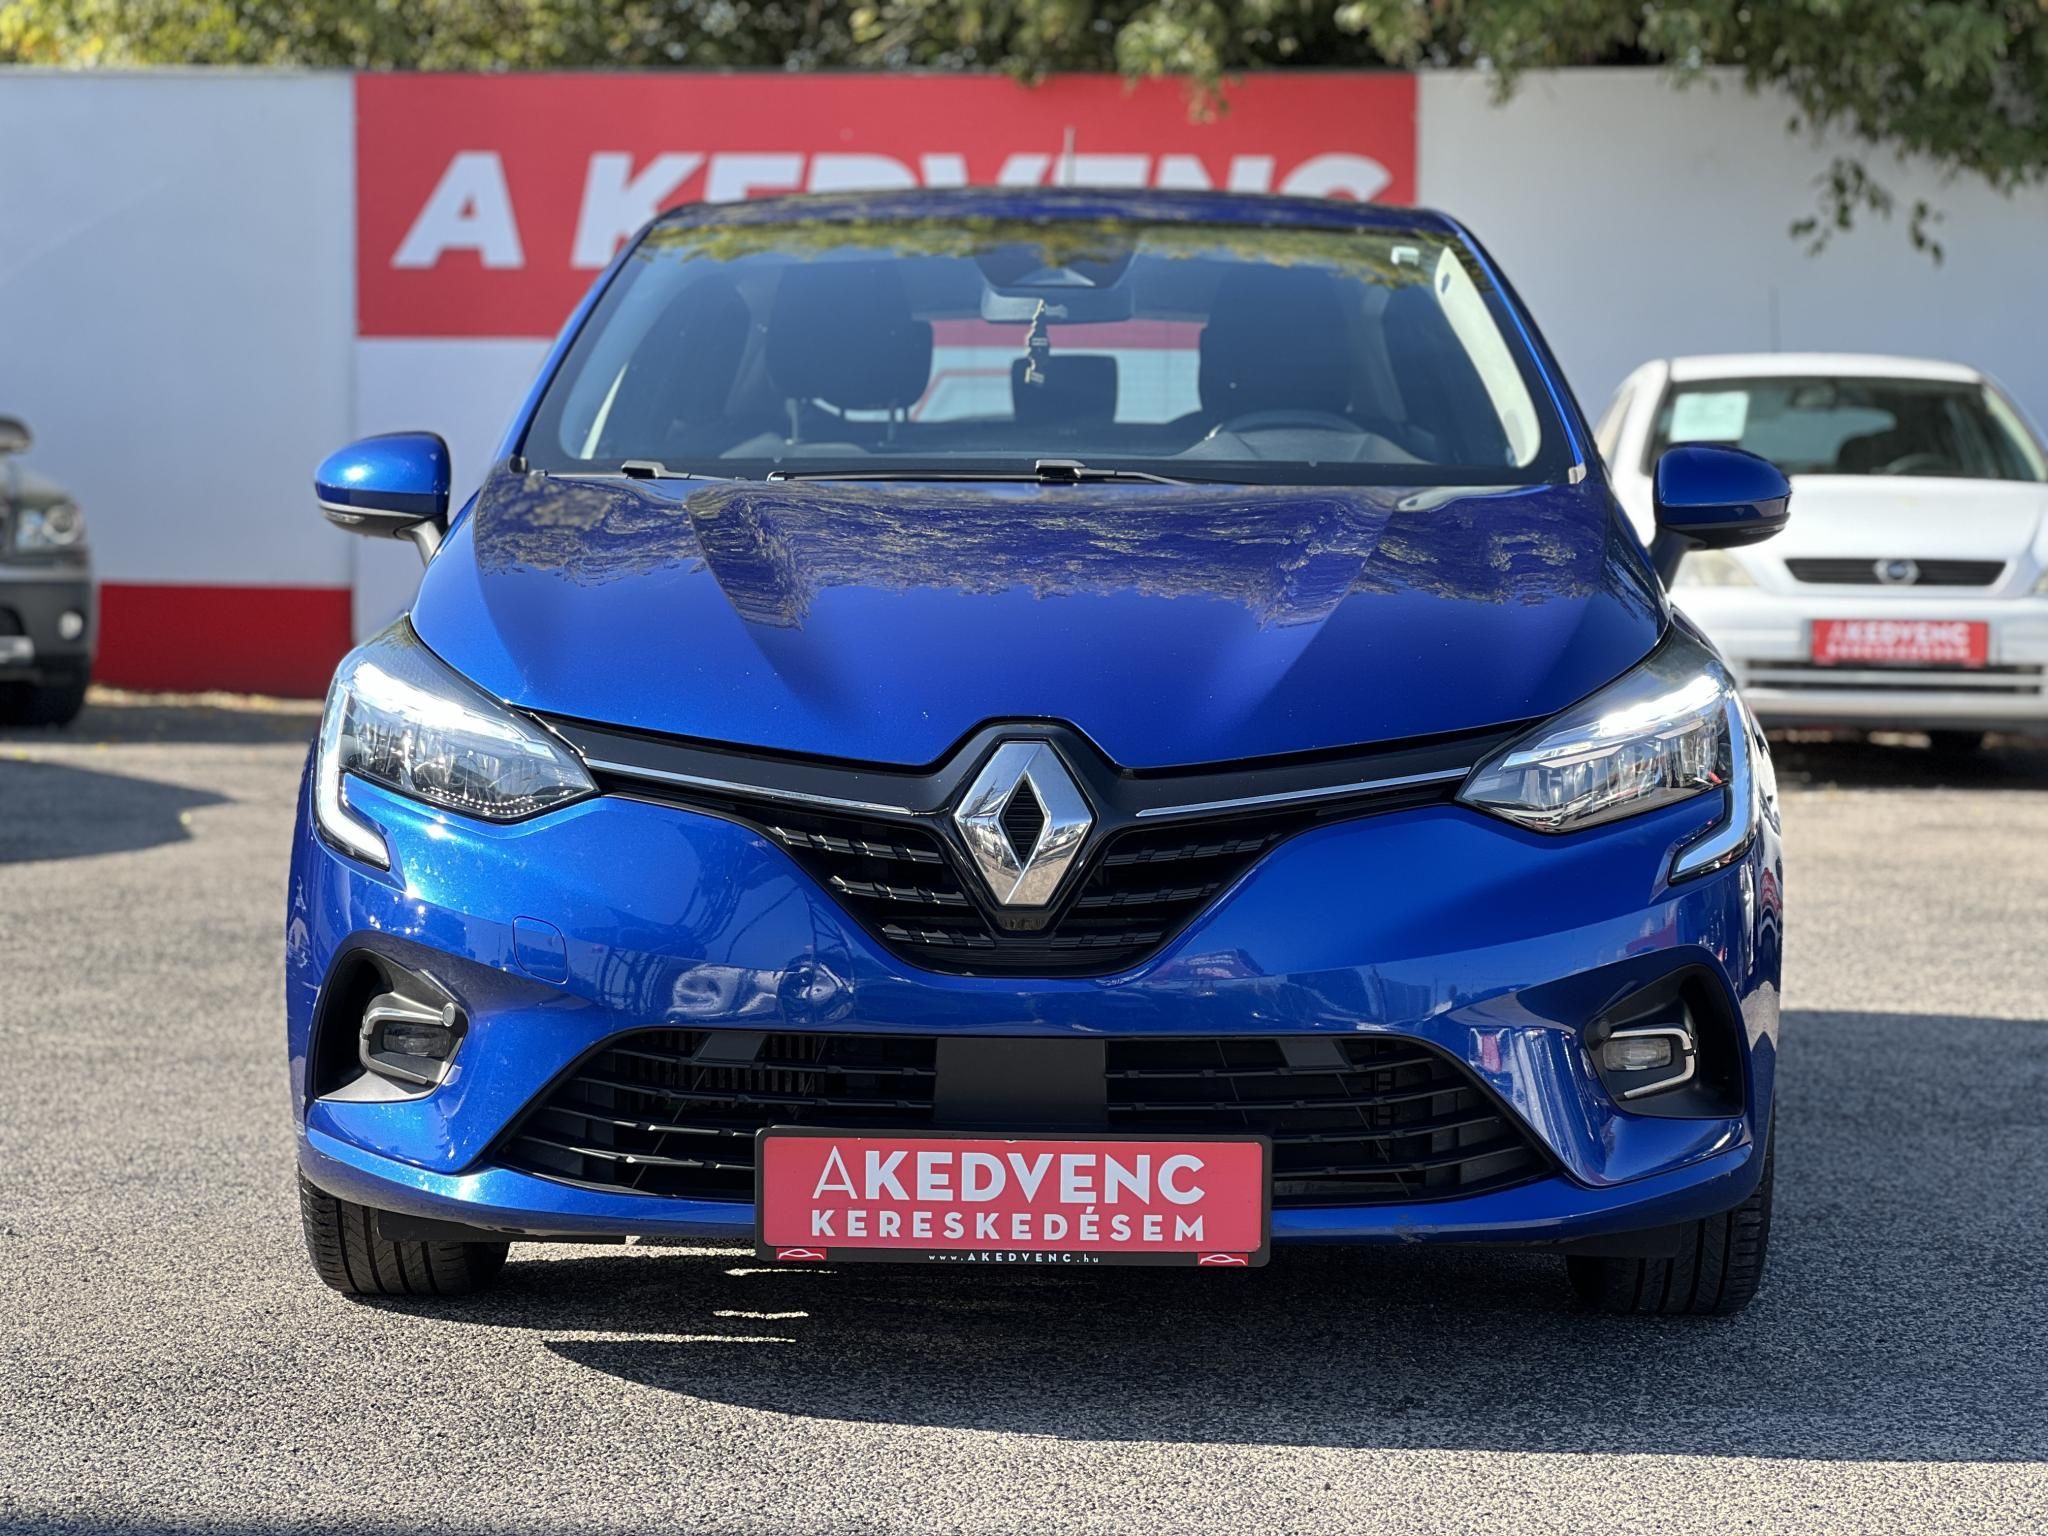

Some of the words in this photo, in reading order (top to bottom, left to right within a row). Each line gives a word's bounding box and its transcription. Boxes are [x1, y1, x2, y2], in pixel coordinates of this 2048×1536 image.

[392, 152, 525, 268] A
[812, 1145, 1205, 1205] AKEDVENC
[811, 1206, 1205, 1242] KERESKEDÉSEM
[928, 1252, 1099, 1264] www.AKEDVENC.hu
